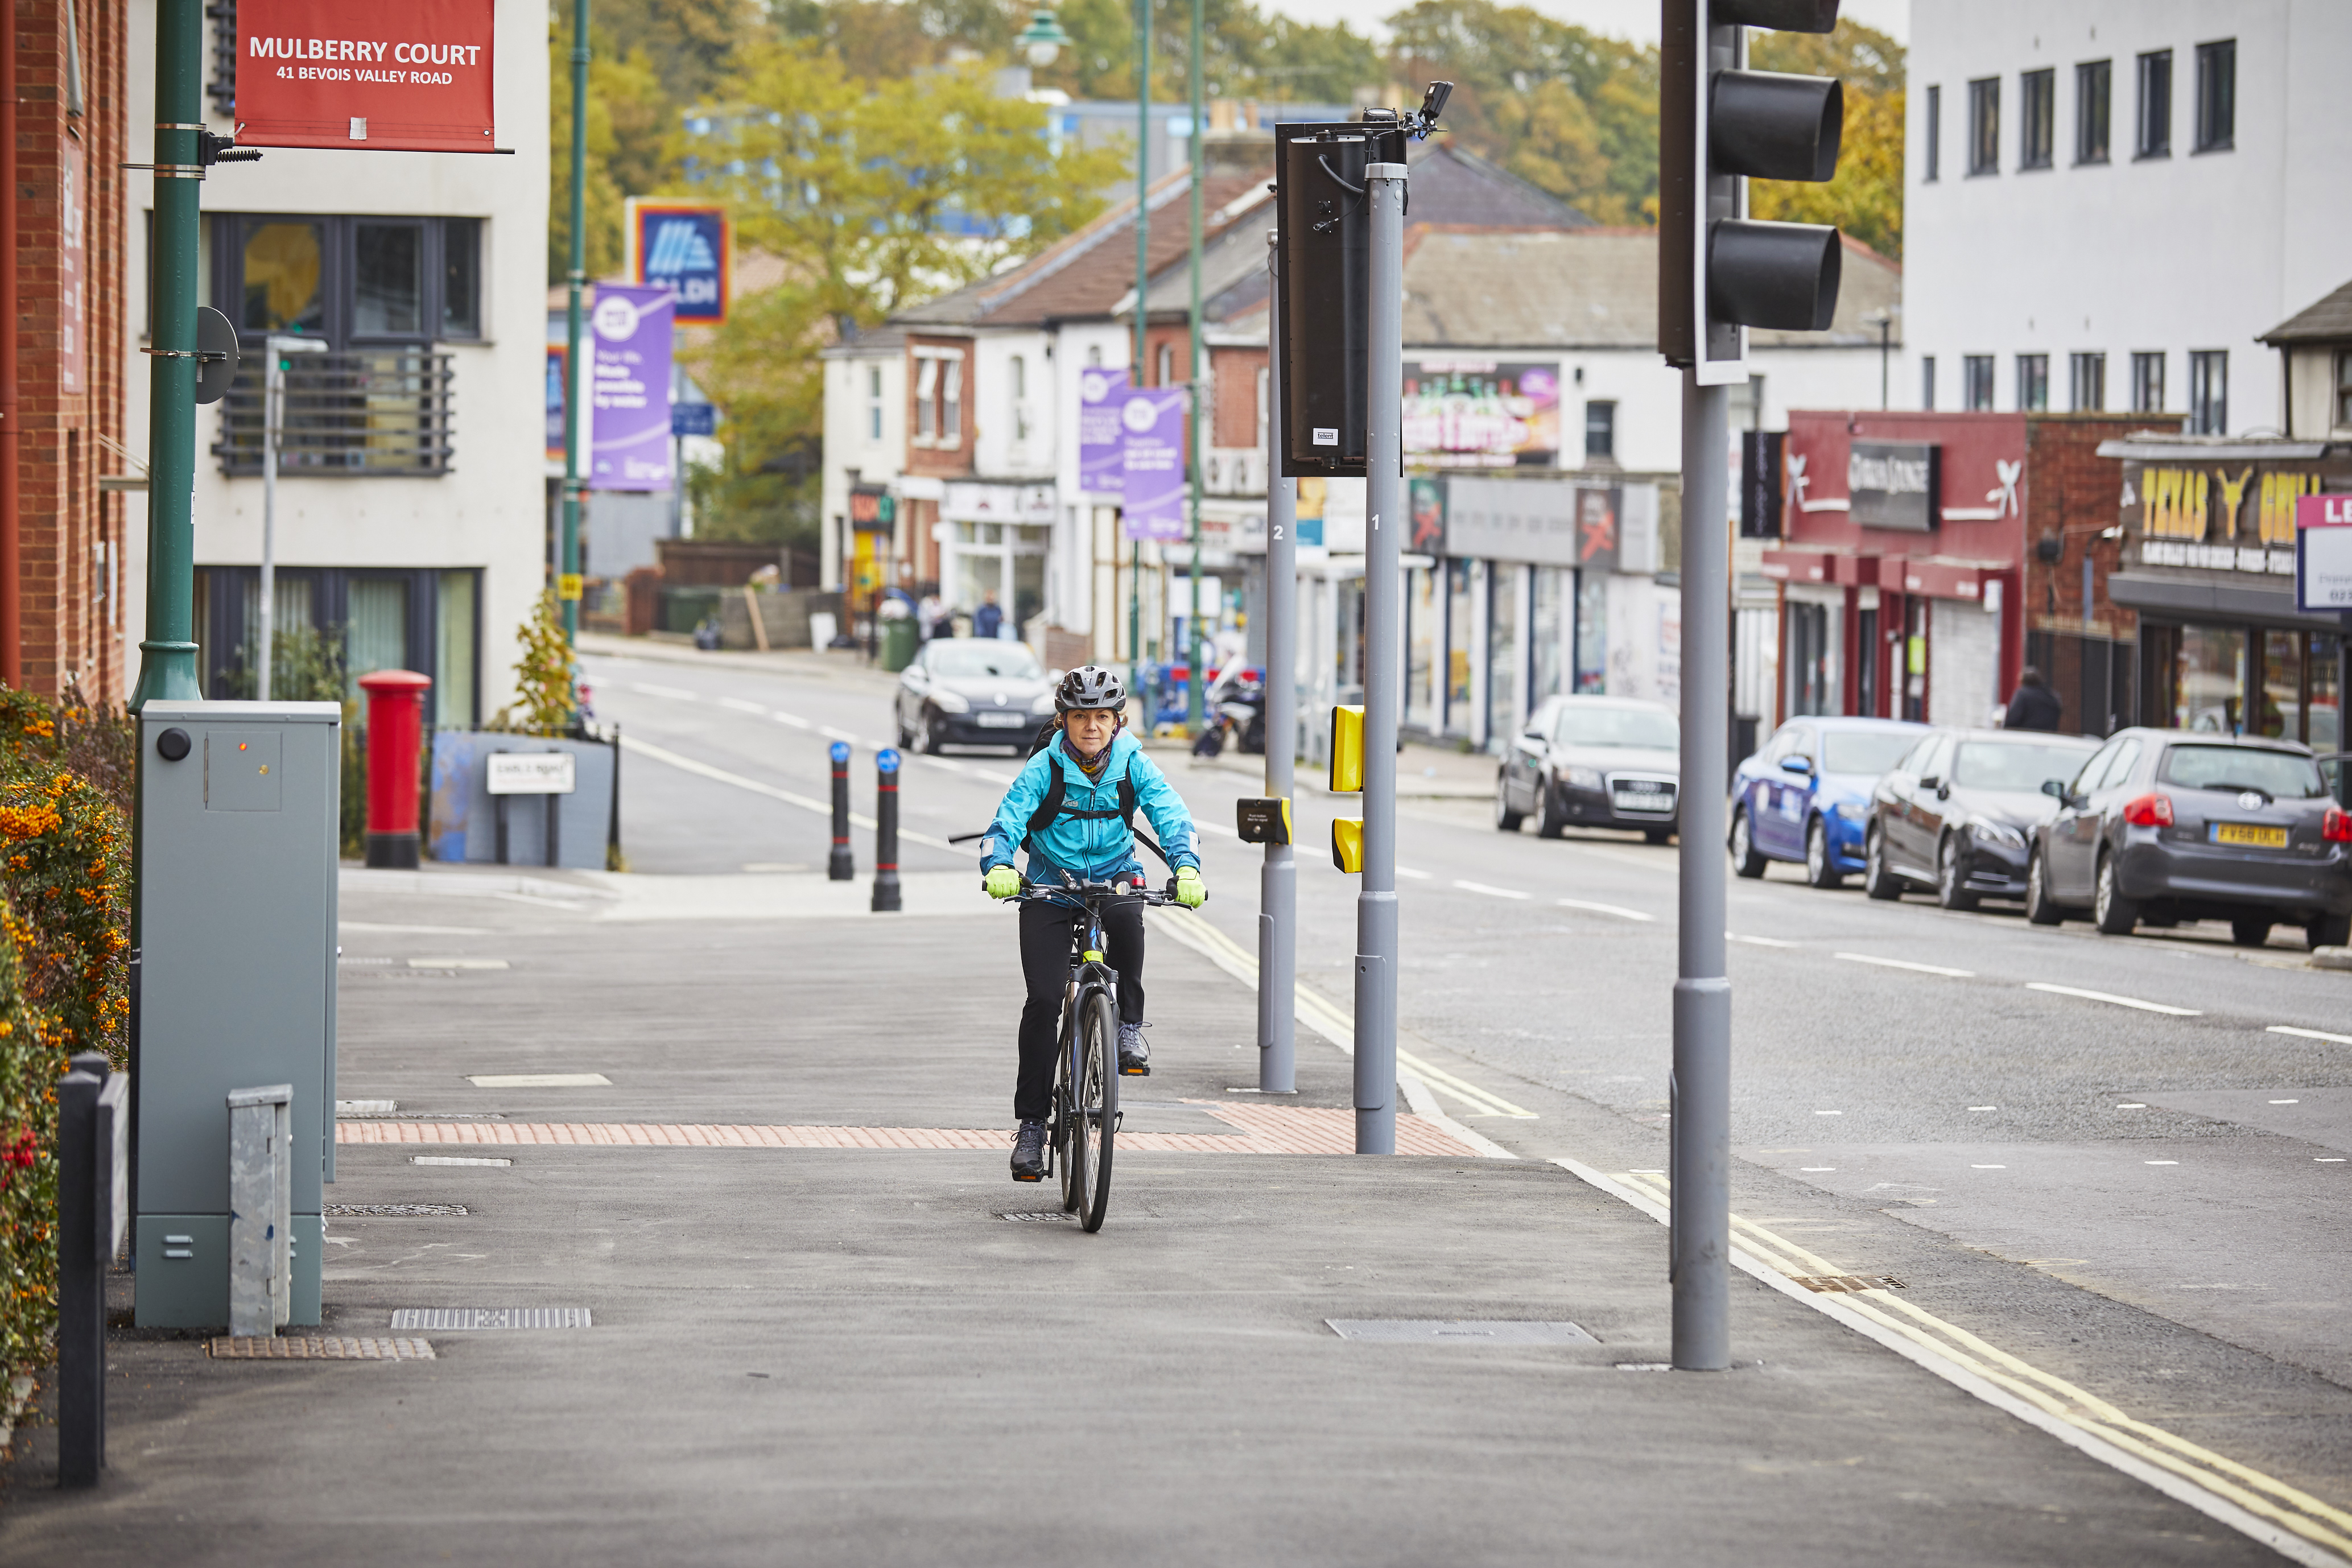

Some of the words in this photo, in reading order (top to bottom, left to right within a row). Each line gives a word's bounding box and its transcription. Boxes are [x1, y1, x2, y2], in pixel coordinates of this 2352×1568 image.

[250, 36, 387, 62] MULBERRY
[395, 43, 481, 65] COURT
[277, 66, 294, 79] 41
[299, 67, 351, 81] BEVOIS
[354, 69, 407, 82] VALLEY
[411, 71, 452, 85] ROAD
[2141, 467, 2209, 543] TEXAS
[1372, 514, 1379, 530] 1
[1273, 525, 1284, 540] 2
